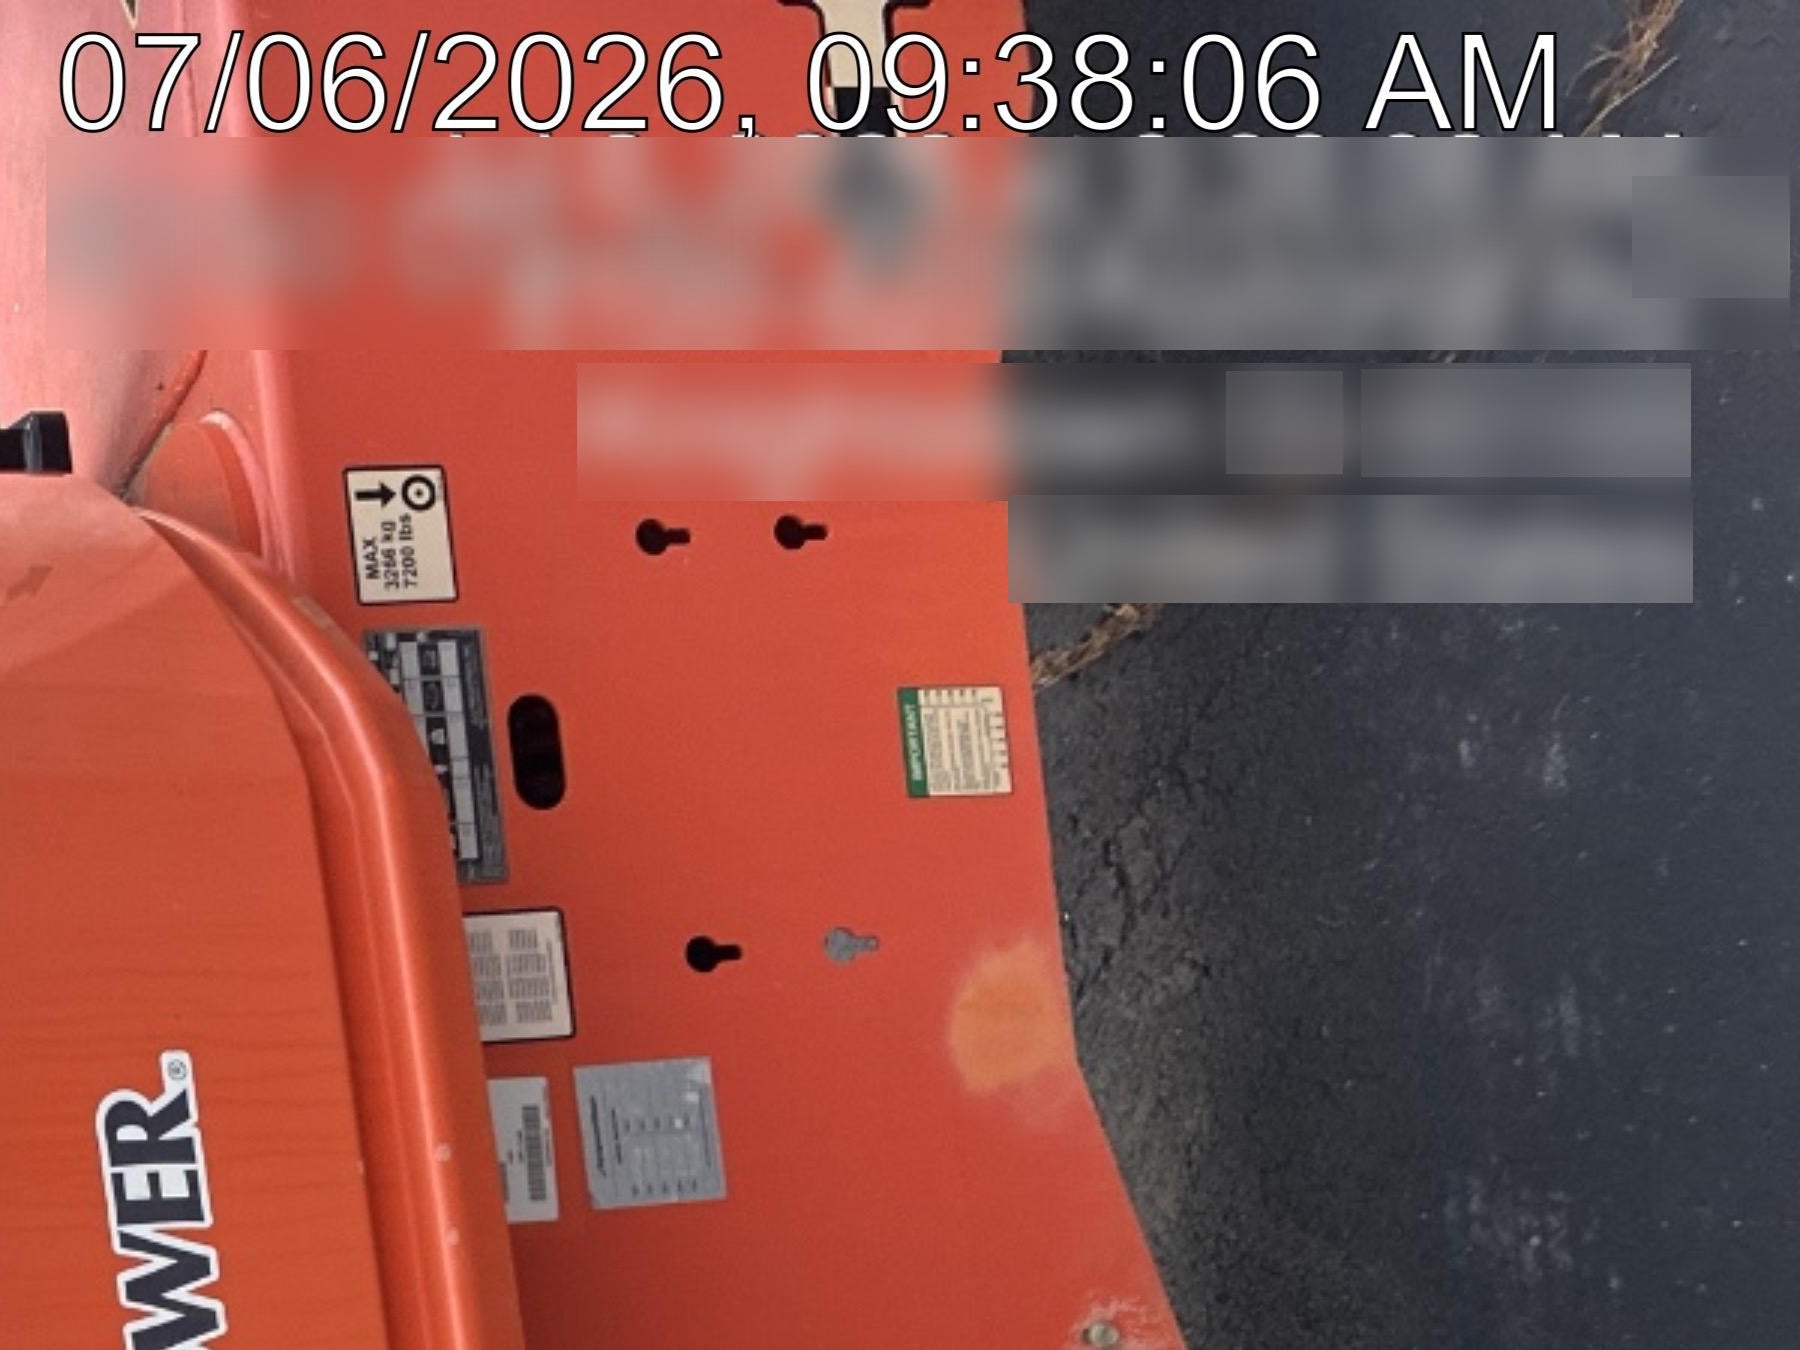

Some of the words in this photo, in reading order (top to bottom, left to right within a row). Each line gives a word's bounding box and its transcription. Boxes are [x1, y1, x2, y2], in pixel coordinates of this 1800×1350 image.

[381, 520, 397, 543] kg
[399, 513, 414, 541] lbs
[362, 537, 381, 580] MAX
[400, 546, 418, 590] 7200
